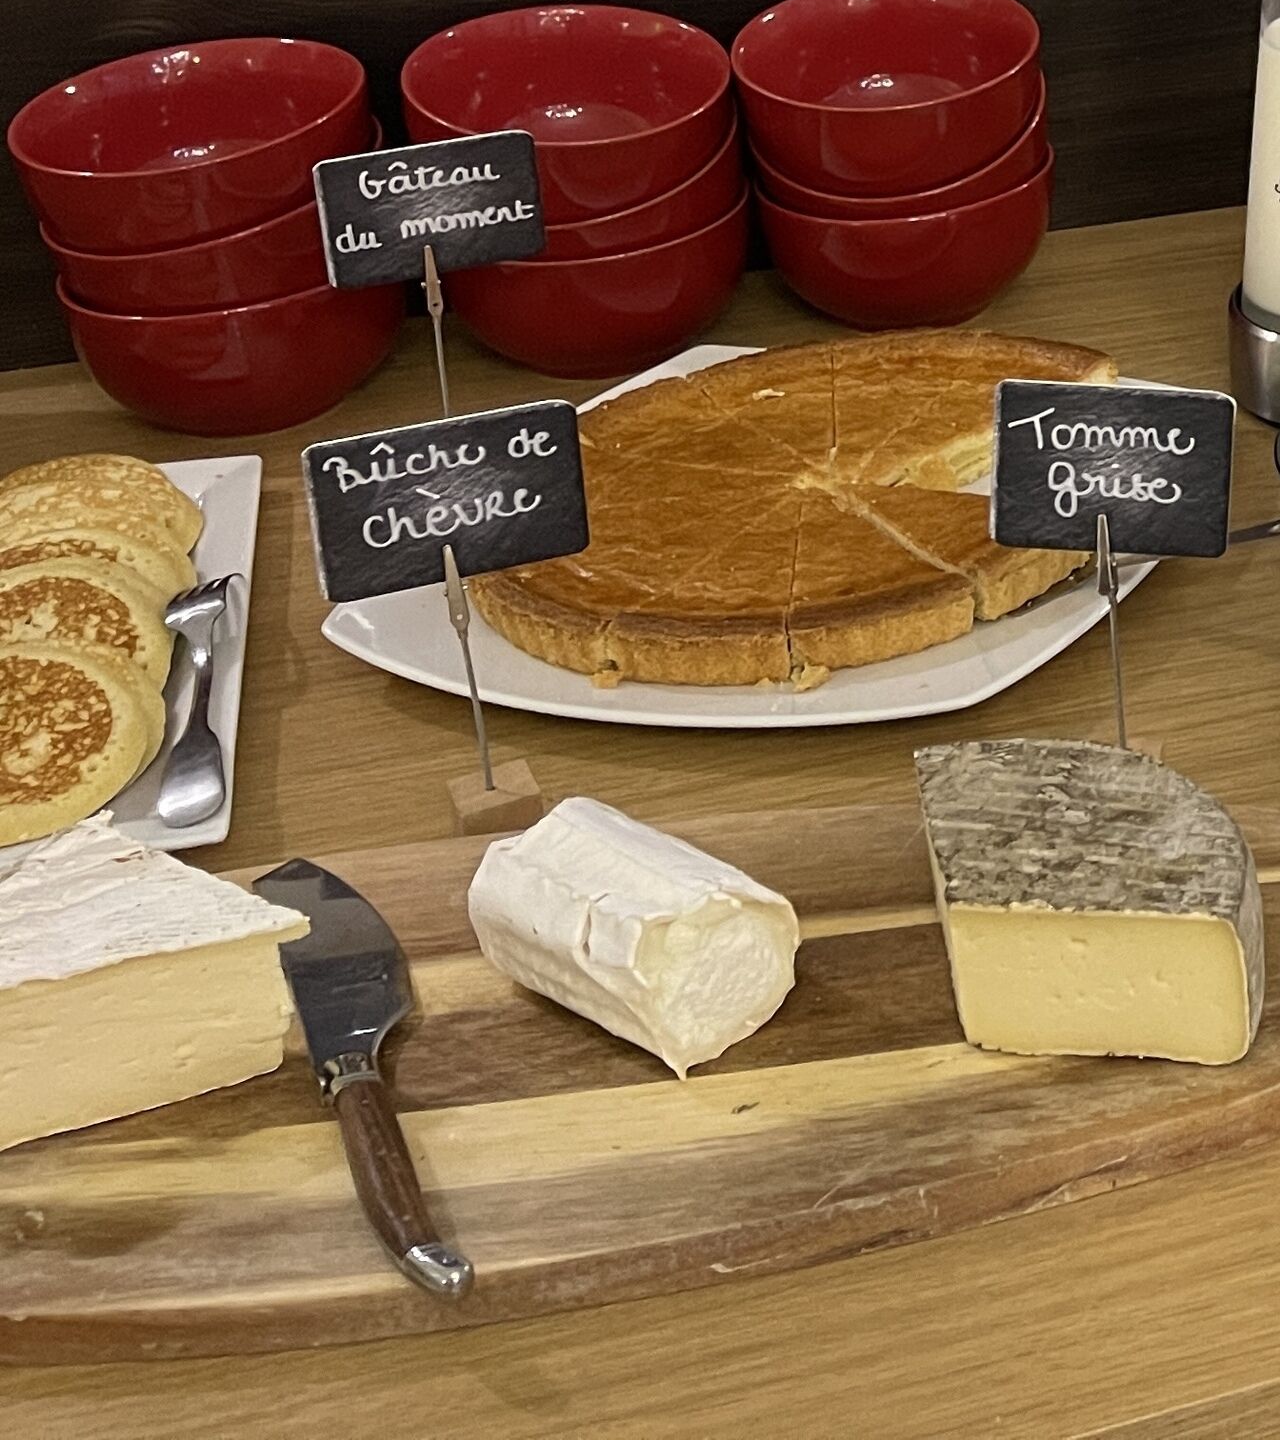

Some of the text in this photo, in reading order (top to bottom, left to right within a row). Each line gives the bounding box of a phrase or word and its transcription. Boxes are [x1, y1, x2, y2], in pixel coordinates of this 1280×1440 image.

[335, 200, 535, 254] du moment
[1007, 407, 1195, 456] Tomme
[322, 428, 557, 494] Bûche de
[1048, 461, 1182, 518] grise
